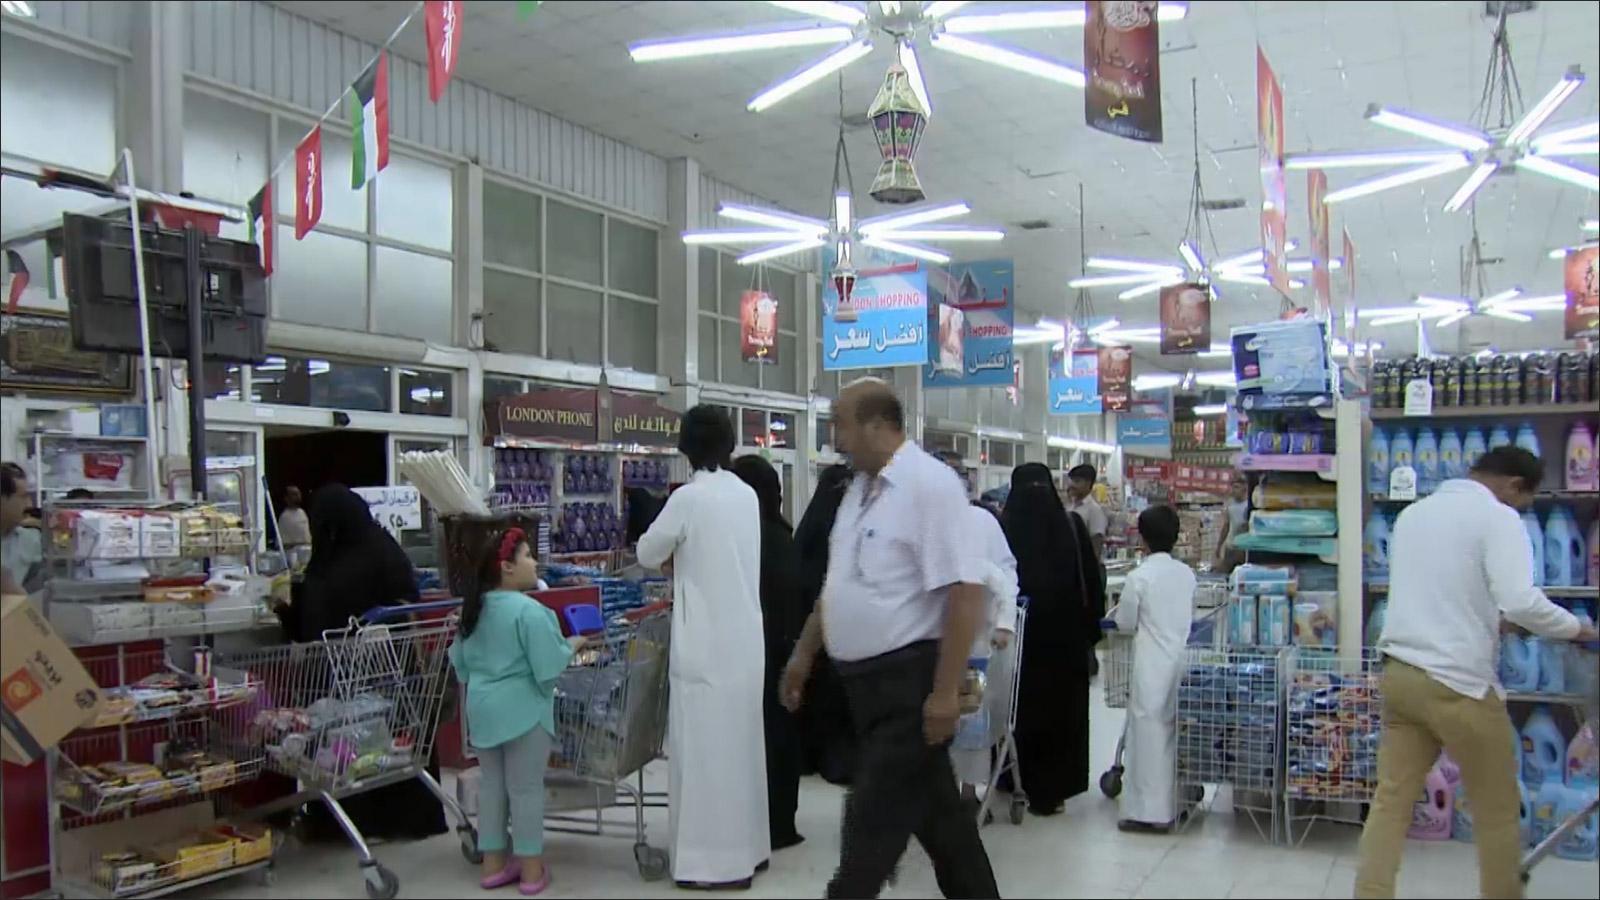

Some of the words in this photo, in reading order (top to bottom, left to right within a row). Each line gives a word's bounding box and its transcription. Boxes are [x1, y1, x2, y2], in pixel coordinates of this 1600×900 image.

[877, 293, 919, 308] SHOPPING
[828, 327, 871, 360] سعر
[875, 321, 923, 352] أفضل
[506, 406, 552, 423] LONDON
[557, 410, 593, 427] PHONE
